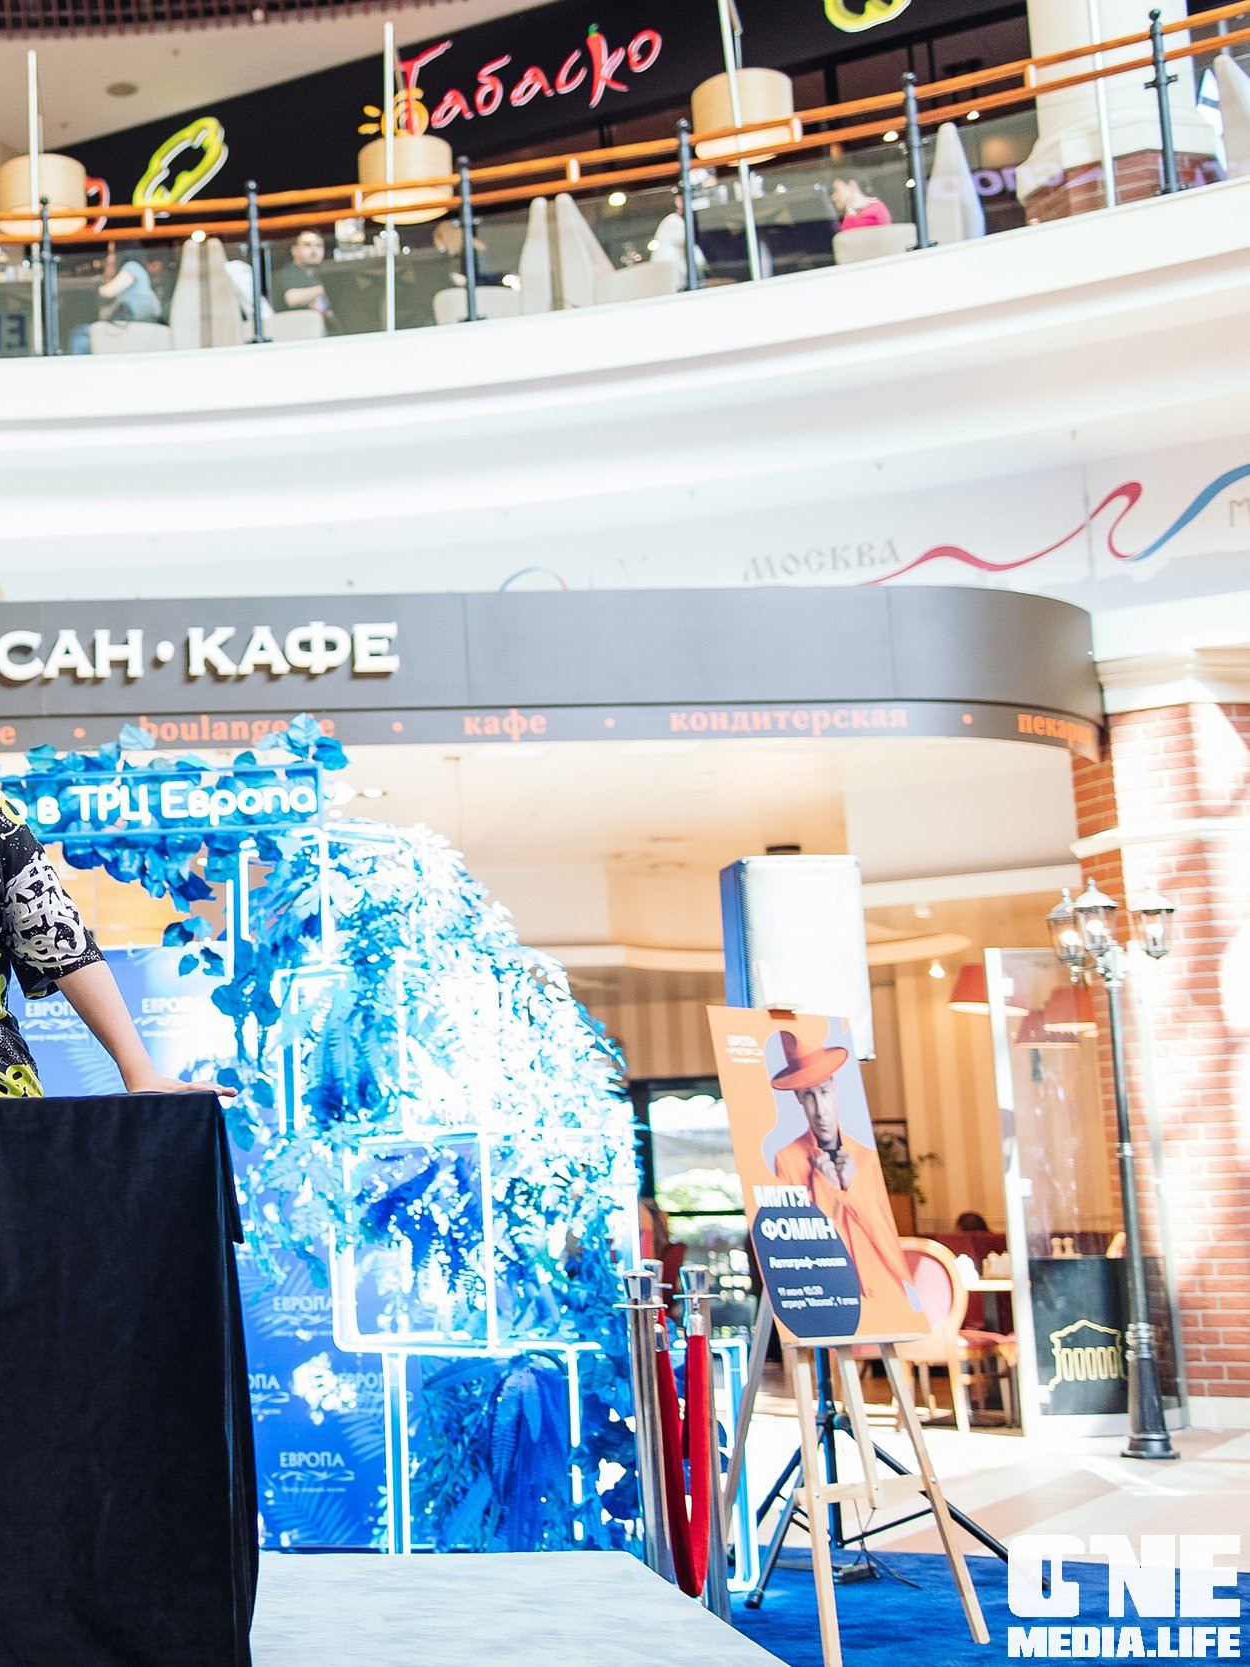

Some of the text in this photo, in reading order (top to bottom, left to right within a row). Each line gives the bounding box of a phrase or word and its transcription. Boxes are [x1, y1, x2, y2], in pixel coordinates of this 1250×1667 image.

[399, 38, 663, 136] Табаско
[743, 538, 901, 582] МОСКВА
[186, 621, 400, 678] КАФЕ
[462, 708, 548, 743] кафе
[669, 708, 909, 737] кондитерская
[71, 784, 153, 827] ТРЦ
[160, 780, 318, 828] Европа
[752, 1184, 811, 1208] МИТЯ
[760, 1217, 838, 1241] ФОМИН
[279, 1451, 346, 1468] ЕВРОПА
